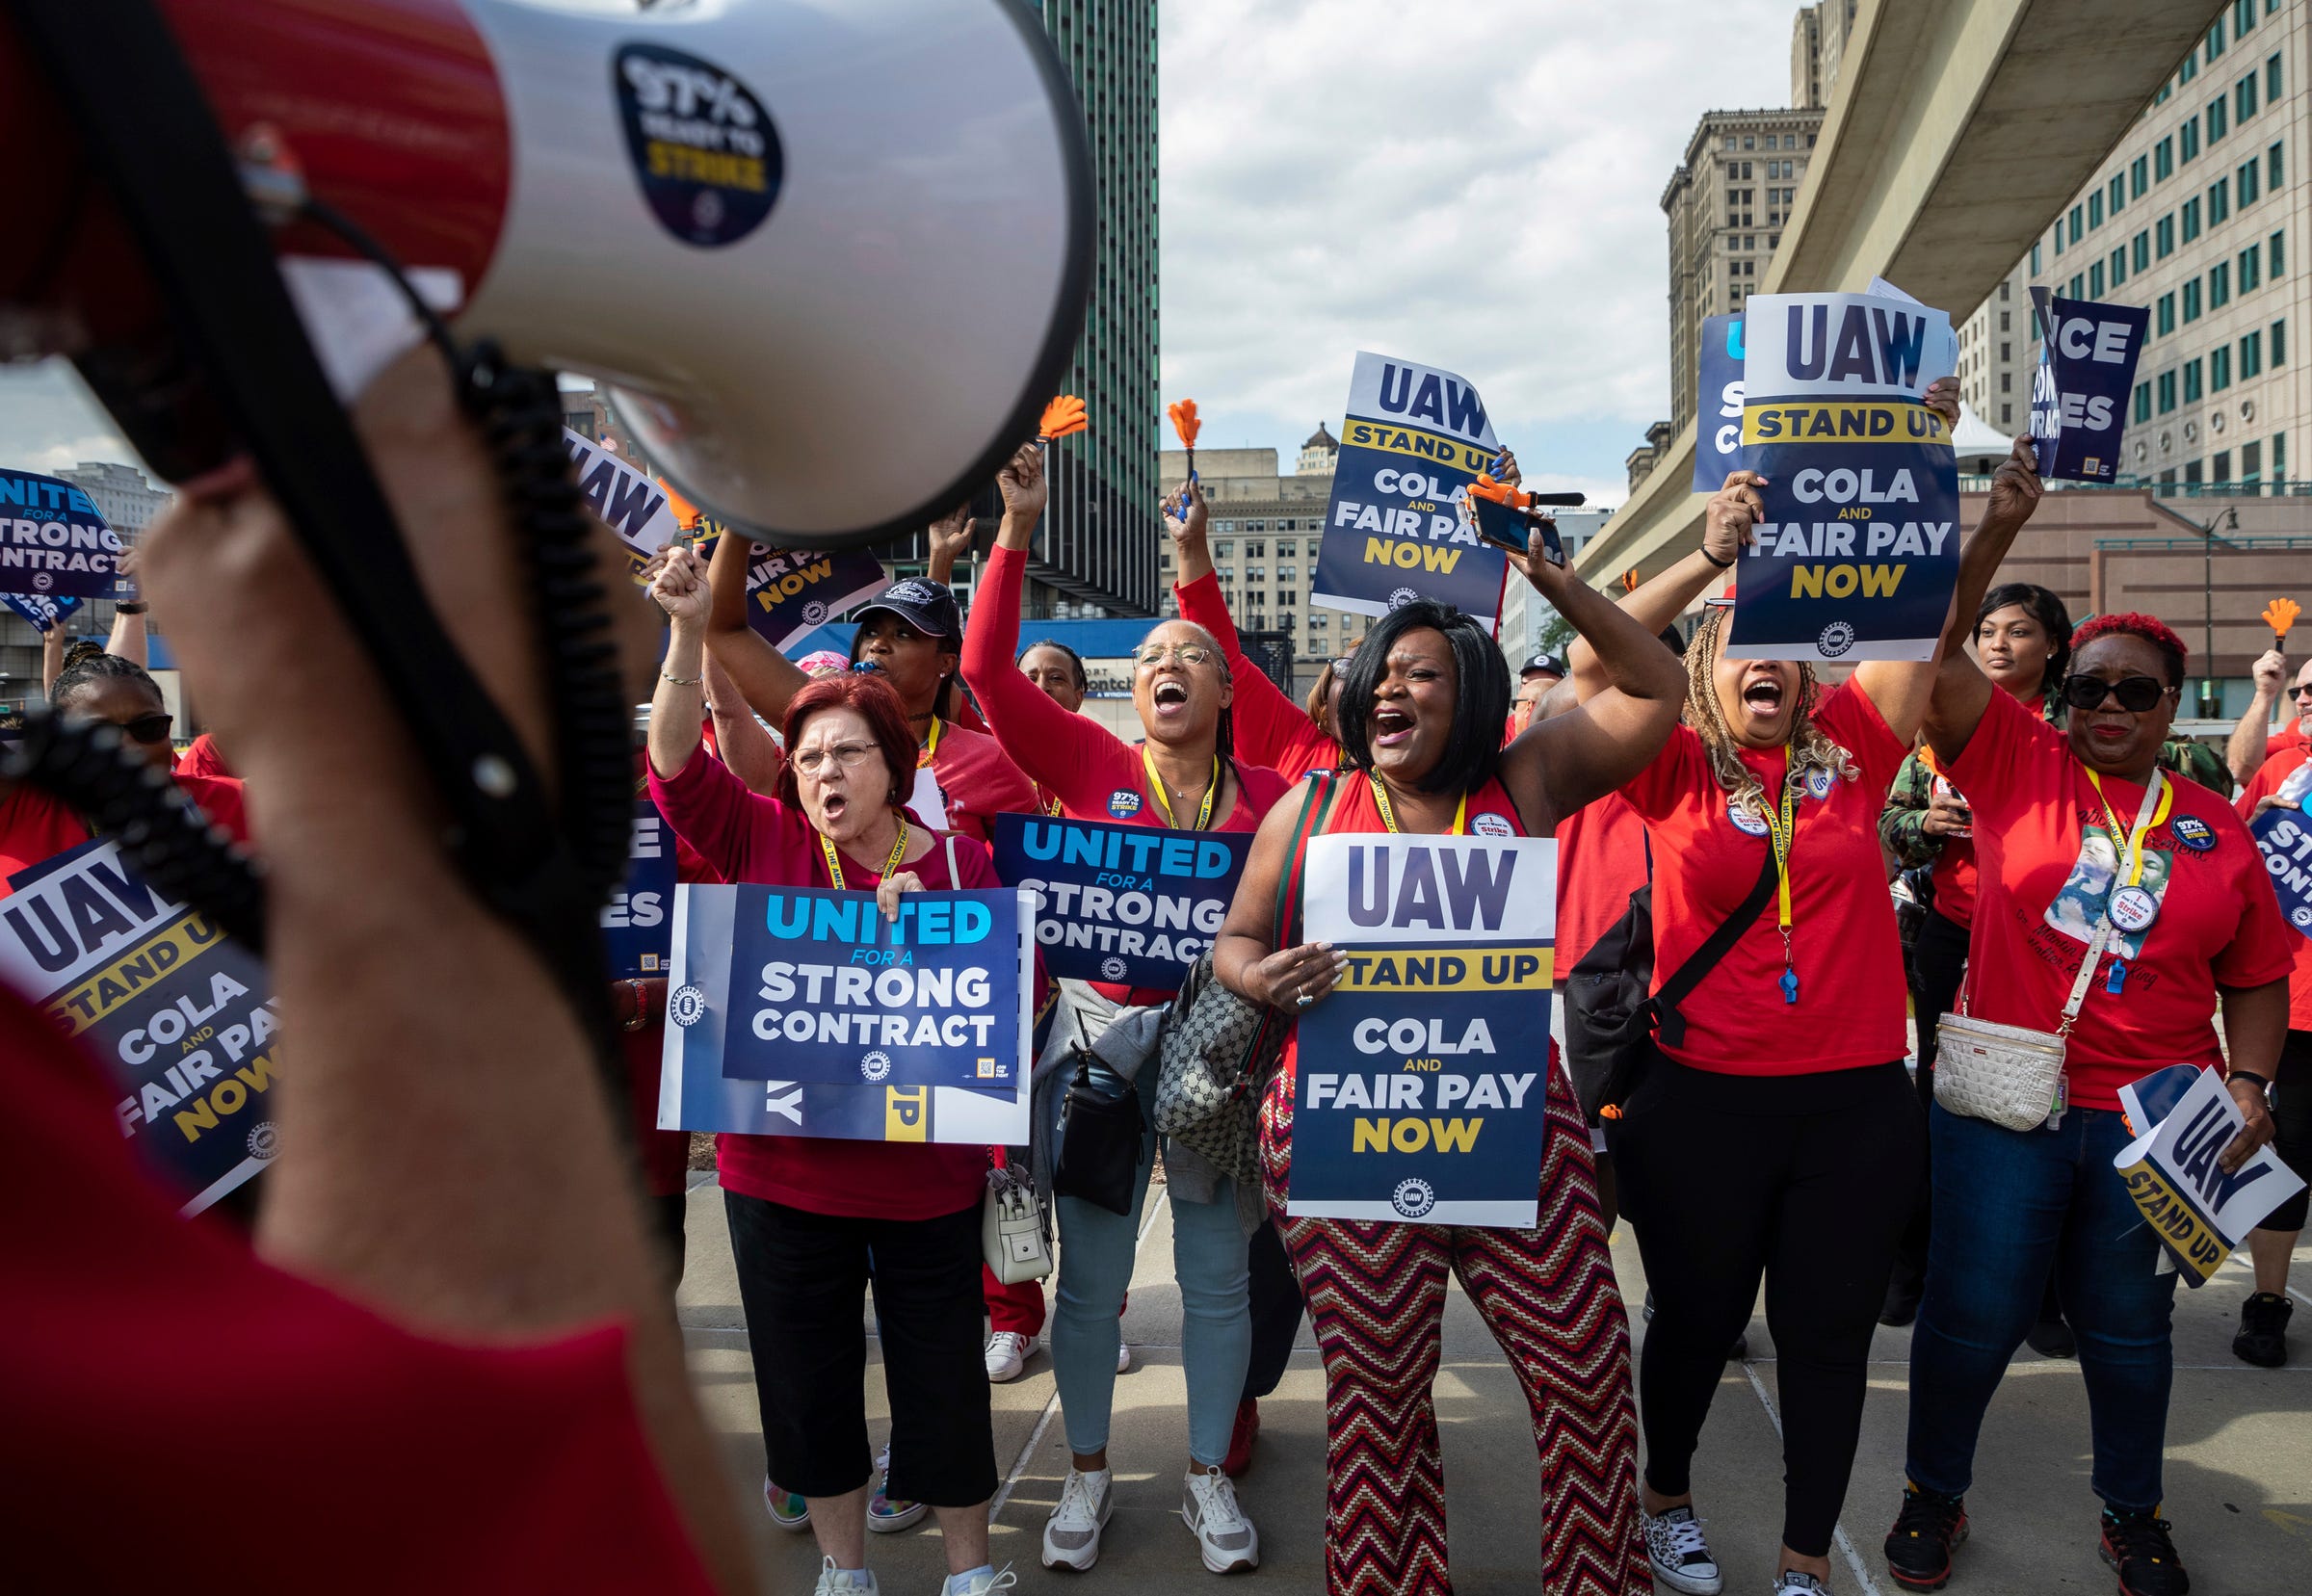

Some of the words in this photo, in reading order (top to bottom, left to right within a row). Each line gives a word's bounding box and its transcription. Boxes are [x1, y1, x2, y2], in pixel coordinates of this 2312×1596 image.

[1786, 304, 1926, 389] UAW
[1379, 363, 1486, 438] UAW
[1756, 408, 1894, 438] STAND
[1907, 409, 1943, 439] UP
[1352, 425, 1456, 461] STAND
[0, 478, 102, 517] NITE
[1374, 468, 1467, 504] COLA
[1792, 468, 1920, 504] COLA
[23, 509, 55, 520] FOR
[57, 512, 67, 522] A
[1407, 500, 1435, 512] AND
[1837, 507, 1872, 520] AND
[1334, 501, 1421, 538] FAIR
[1429, 514, 1491, 548] PA
[1748, 521, 1855, 558] FAIR
[1866, 521, 1952, 558] PAY
[1363, 536, 1462, 575] NOW
[756, 559, 832, 614] NOW
[893, 586, 922, 597] Ford
[1790, 563, 1907, 599] NOW
[1113, 792, 1139, 801] 97%
[1380, 800, 1396, 830] STRONG
[2177, 820, 2203, 829] 97%
[828, 850, 837, 865] THE
[1023, 822, 1232, 878] UNITED
[1774, 831, 1784, 863] DREAM
[1095, 872, 1135, 889] FOR
[1139, 877, 1153, 892] A
[1348, 846, 1518, 931] UAW
[766, 894, 991, 945] UNITED
[1018, 878, 1225, 933] STRONG
[2117, 901, 2143, 920] Strike
[851, 949, 895, 965] FOR
[899, 951, 913, 965] A
[1482, 955, 1538, 985] UP
[2027, 935, 2064, 969] Walter
[2033, 924, 2078, 957] Martin
[2127, 965, 2159, 991] King
[44, 940, 180, 1033] STAND
[758, 961, 990, 1008] STRONG
[118, 971, 250, 1065] COLA
[751, 1007, 995, 1047] CONTRACT
[182, 1025, 214, 1055] AND
[1353, 1018, 1496, 1055] COLA
[1403, 1060, 1441, 1072] AND
[115, 1049, 223, 1139] FAIR
[173, 1044, 287, 1143] NOW
[1306, 1074, 1423, 1110] FAIR
[1436, 1073, 1537, 1110] PAY
[1353, 1117, 1484, 1153] NOW
[2172, 1094, 2273, 1216] UAW
[1405, 1192, 1421, 1201] UAW
[2126, 1171, 2194, 1241] STAND
[2189, 1232, 2220, 1267] UP
